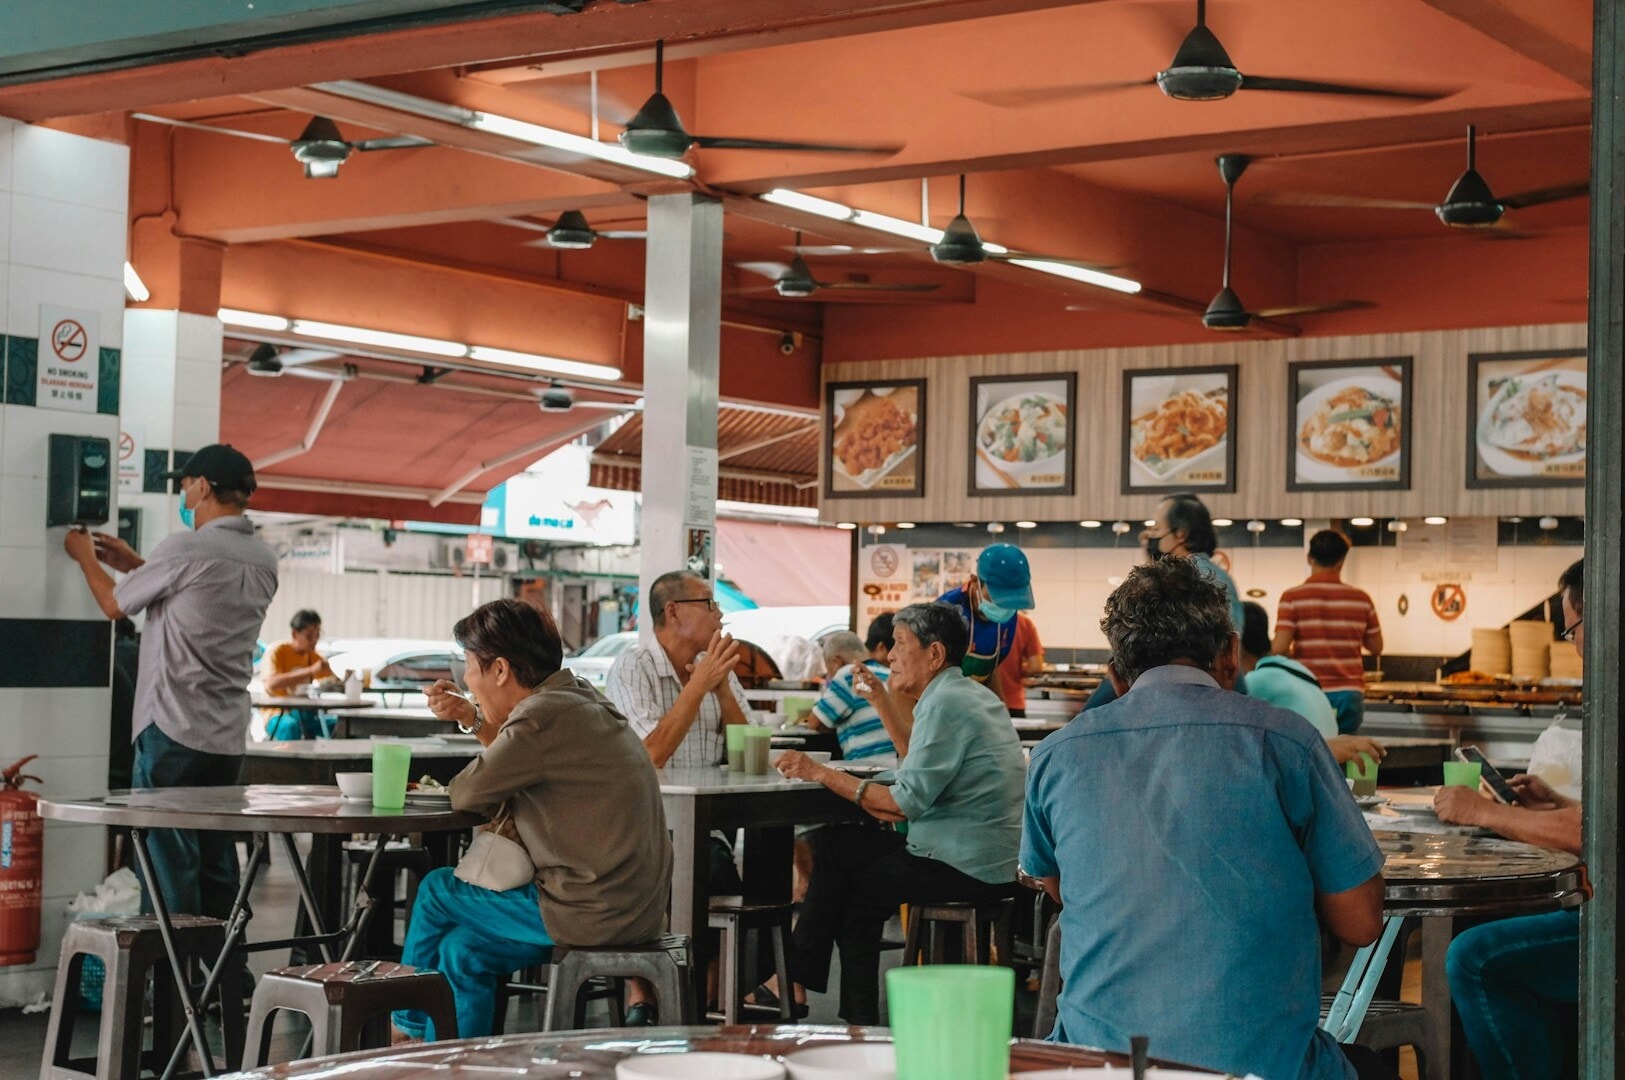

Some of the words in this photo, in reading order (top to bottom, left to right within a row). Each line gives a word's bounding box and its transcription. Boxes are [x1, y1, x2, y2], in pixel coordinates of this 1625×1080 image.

[48, 368, 57, 376] NO
[59, 369, 88, 380] SMOKING
[41, 377, 67, 386] DILARANG
